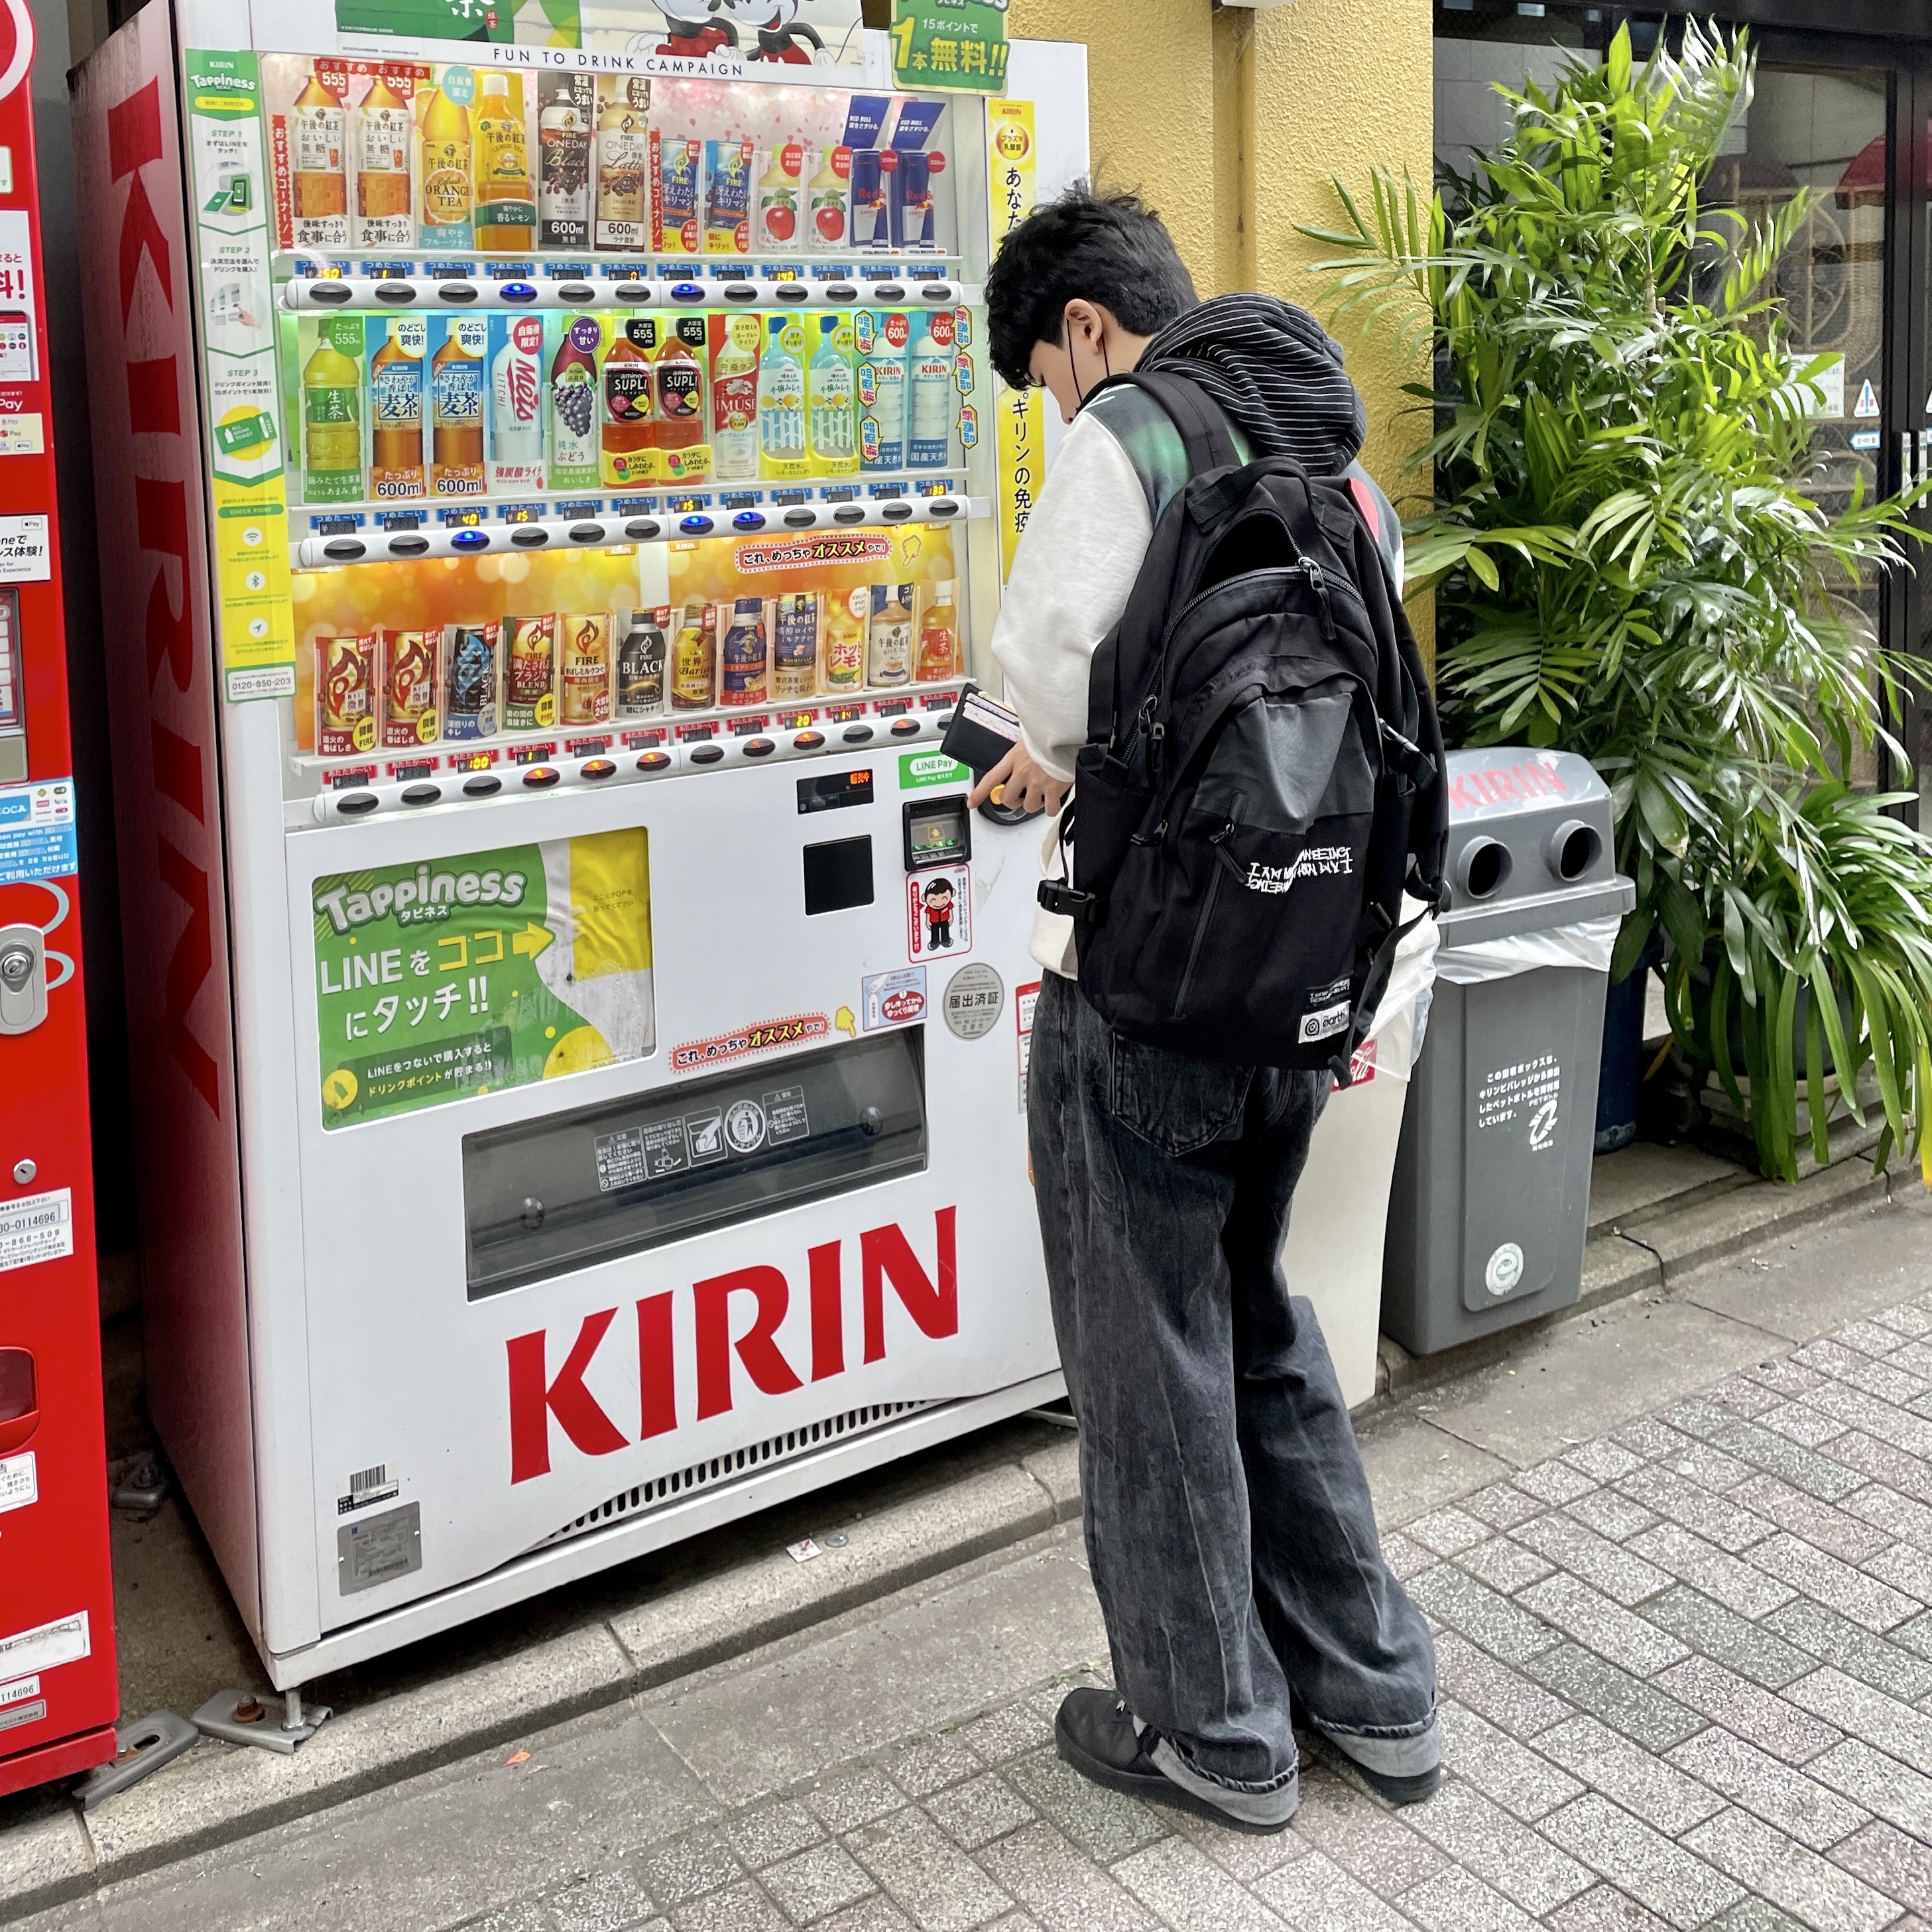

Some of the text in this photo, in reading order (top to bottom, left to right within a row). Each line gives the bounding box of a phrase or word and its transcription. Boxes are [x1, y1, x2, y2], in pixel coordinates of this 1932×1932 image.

[922, 18, 979, 34] 15ポイントで
[892, 17, 1008, 77] 1本無料!!
[319, 60, 369, 73] おすすめ
[494, 48, 743, 76] FUN TO DRINK CAMPAIGN
[378, 64, 426, 77] おすすめ
[190, 73, 256, 90] Tappiness
[322, 73, 346, 87] 555
[300, 119, 339, 131] 午後の紅茶
[365, 119, 404, 133] 午後の紅茶
[300, 133, 340, 143] おいしい
[365, 133, 405, 144] おいしい
[301, 143, 326, 153] 無糖
[365, 143, 390, 154] 無糖
[546, 139, 588, 151] ONEDAY
[605, 141, 644, 151] ONEDAY
[672, 176, 689, 185] FIRE
[726, 178, 743, 186] FIRE
[425, 184, 470, 196] ORANGE
[437, 196, 463, 208] TEA
[303, 219, 343, 228] 後味すっきり
[367, 219, 408, 228] 後味すっきり
[496, 211, 531, 223] 香るレモン
[550, 221, 585, 235] 600ml
[607, 223, 639, 235] 600ml
[297, 229, 347, 243] 食事に合う
[361, 229, 411, 243] 食事に合う
[335, 322, 361, 331] たっぷり
[398, 322, 426, 333] のどごし
[458, 322, 487, 333] のどごし
[574, 326, 598, 334] すっきり
[683, 326, 703, 337] 555
[955, 308, 969, 344] 新商品
[633, 329, 654, 339] 555
[858, 315, 873, 351] 新商品
[400, 335, 424, 346] 爽快!
[460, 334, 485, 346] 爽快!
[520, 336, 540, 348] 限定!
[578, 336, 594, 346] 甘い
[719, 362, 755, 372] 免疫ケア
[876, 366, 902, 376] KIRIN
[922, 365, 947, 374] KIRIN
[957, 355, 972, 391] 新商品
[383, 375, 416, 385] さわやか
[443, 375, 476, 384] さわやか
[615, 379, 648, 391] SUPLI
[666, 375, 698, 388] SUPLI
[861, 367, 876, 403] 新商品
[387, 384, 414, 393] 香ばし
[447, 383, 474, 392] 香ばし
[497, 373, 507, 407] LITCHI
[0, 398, 23, 412] Pay
[328, 389, 343, 420] 生茶
[380, 393, 419, 418] 麦茶
[440, 391, 479, 416] 麦茶
[961, 408, 976, 444] 新商品
[558, 440, 579, 450] 純水
[863, 421, 878, 457] 新商品
[557, 452, 585, 462] ぶどう
[385, 471, 417, 480] たっぷり
[444, 467, 477, 477] たっぷり
[495, 466, 542, 479] 強炭酸ライチ
[377, 481, 422, 497] 600ml
[437, 479, 482, 493] 600ml
[676, 542, 695, 550] KIRIN
[107, 72, 221, 1124] KIRIN
[833, 640, 862, 656] ホット
[939, 631, 949, 654] 生茶
[575, 655, 599, 666] FIRE
[623, 659, 664, 674] BLACK
[514, 669, 549, 682] ブラジル
[232, 678, 291, 691] 0120-850-203
[479, 665, 491, 707] BLACK
[422, 728, 436, 739] FIRE
[359, 737, 373, 749] FIRE
[916, 758, 953, 771] LINE Pay
[1448, 761, 1569, 810] KIRIN
[316, 865, 525, 932] Tappiness
[400, 904, 448, 923] タピネス
[321, 947, 430, 995] LINEを
[949, 991, 999, 1010] 届出済証
[345, 976, 489, 1041] にタッチ!!
[367, 1042, 492, 1079] LINEをつないで購入すると
[505, 1204, 959, 1486] KIRIN
